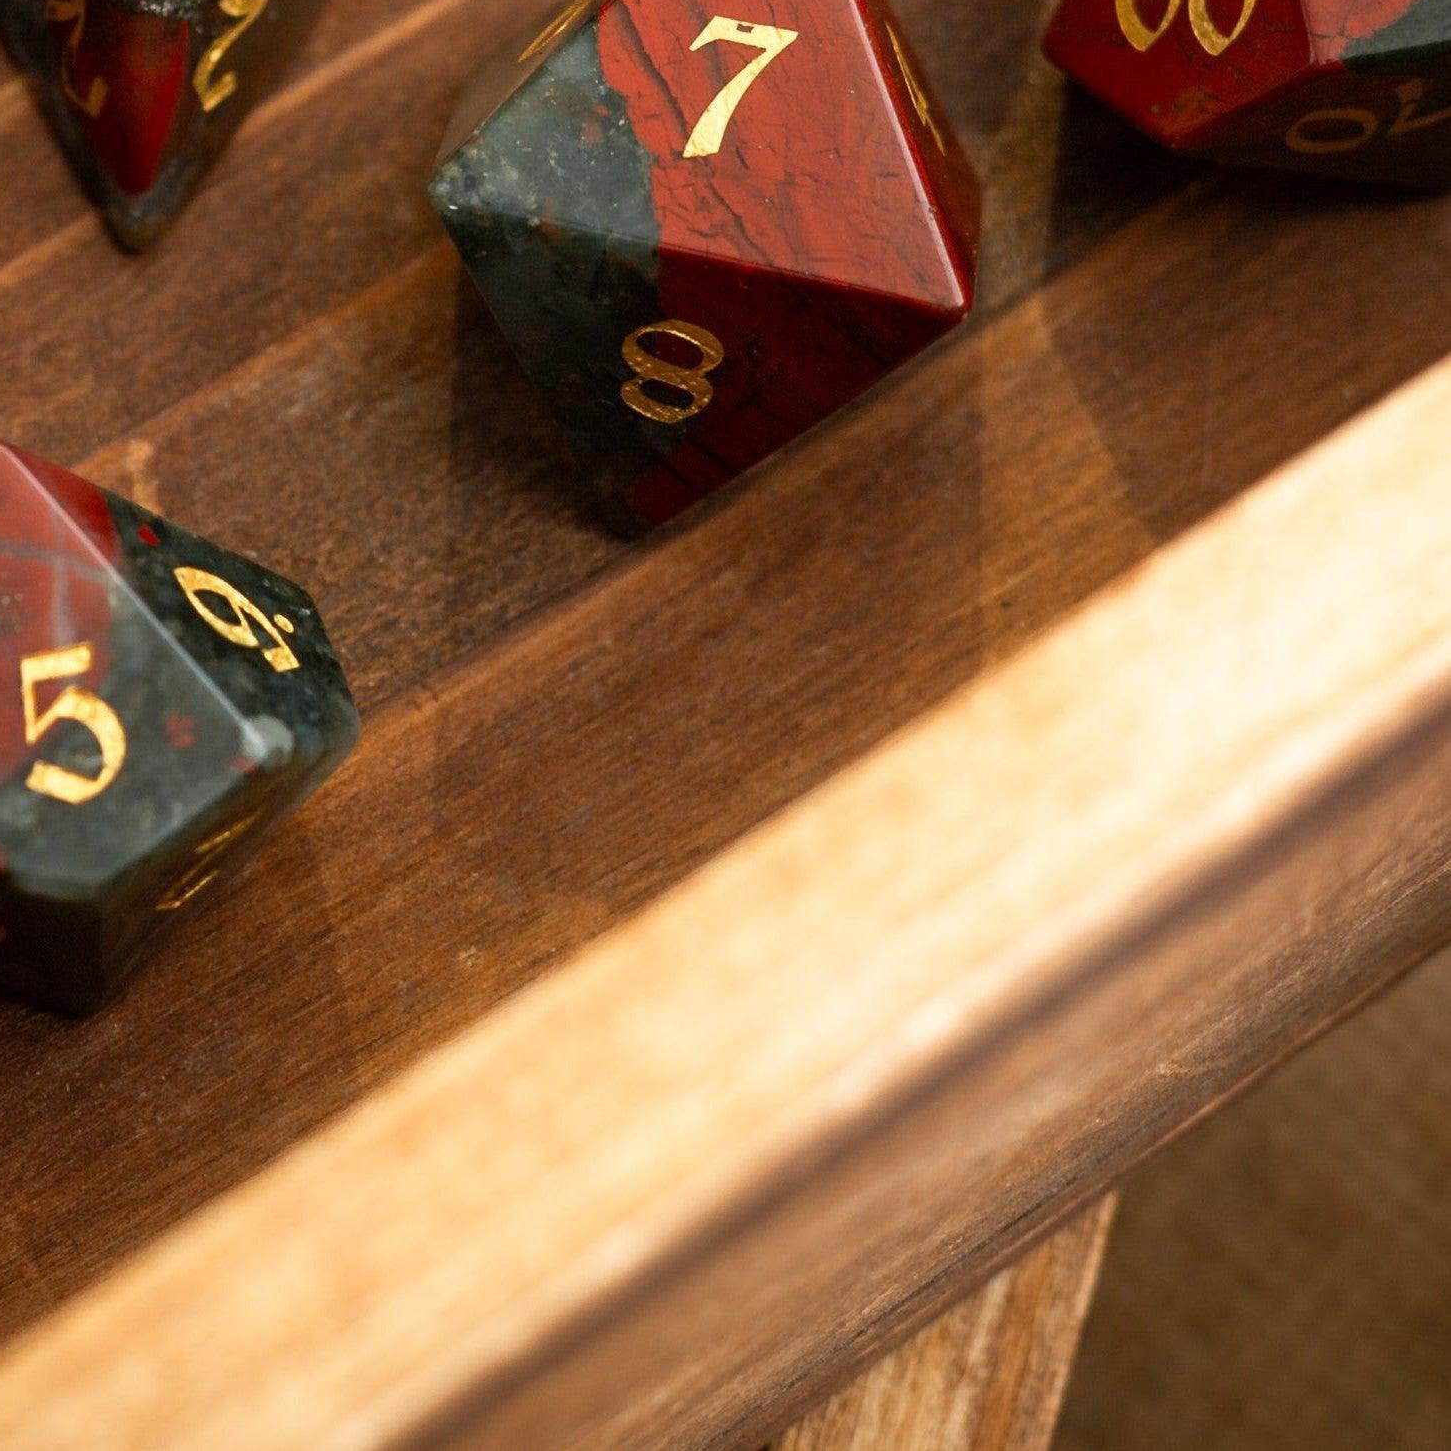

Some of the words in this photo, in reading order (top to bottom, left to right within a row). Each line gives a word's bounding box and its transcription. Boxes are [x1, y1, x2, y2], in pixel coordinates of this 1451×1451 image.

[682, 15, 798, 158] 7
[620, 319, 724, 423] 8
[21, 642, 126, 805] 5
